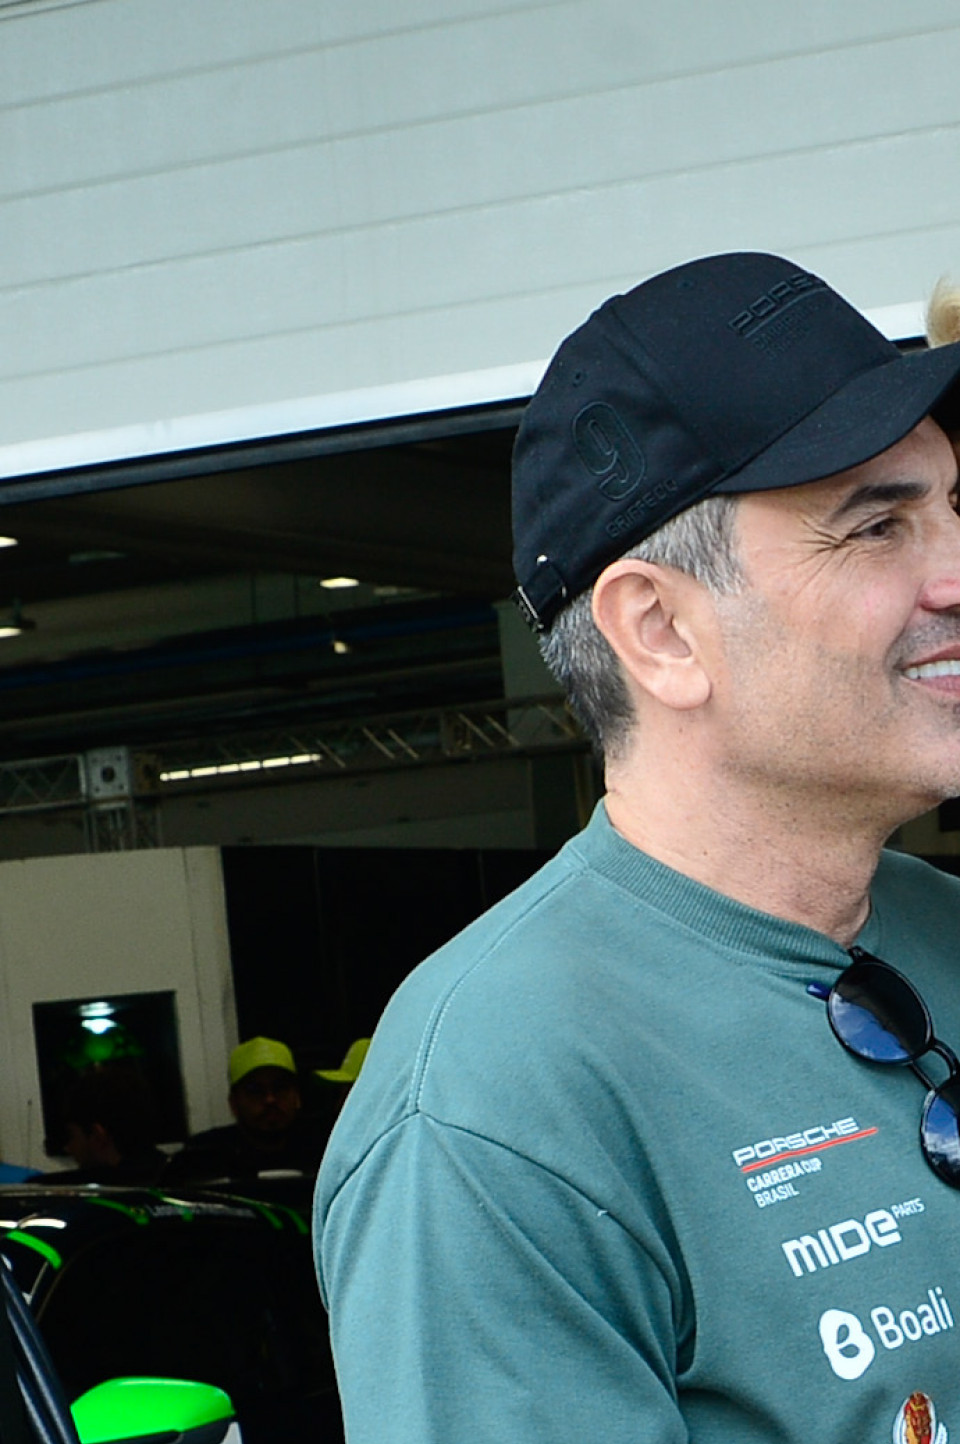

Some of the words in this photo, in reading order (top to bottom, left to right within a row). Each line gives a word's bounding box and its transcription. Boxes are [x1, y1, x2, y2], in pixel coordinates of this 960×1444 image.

[571, 400, 646, 503] 9
[732, 1116, 860, 1167] PORSCHE
[746, 1162, 804, 1193] CARRERA
[800, 1157, 823, 1174] CUP
[754, 1183, 801, 1209] BRASIL
[890, 1197, 925, 1219] PARTS
[870, 1285, 954, 1350] Boali
